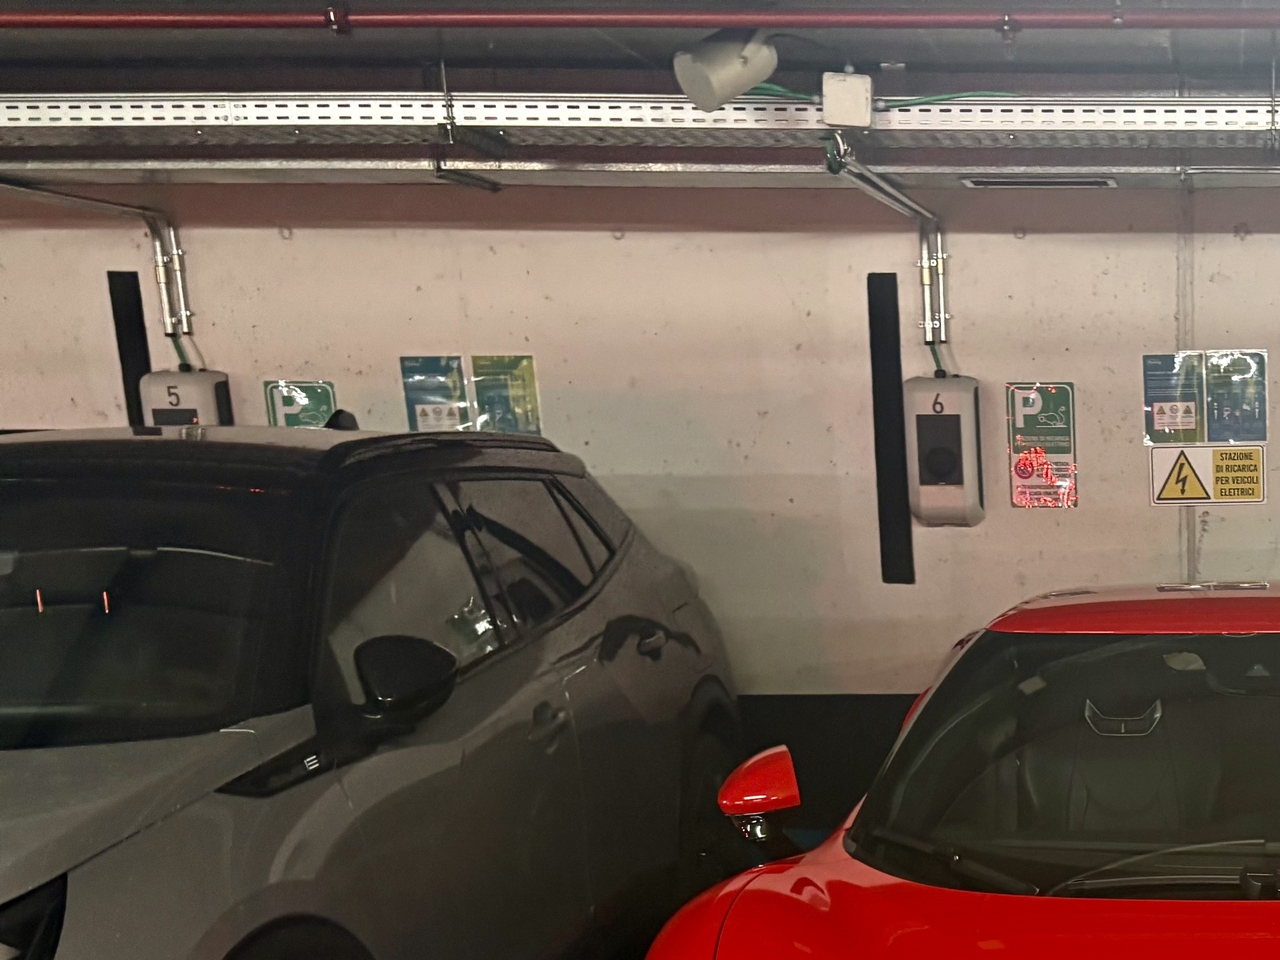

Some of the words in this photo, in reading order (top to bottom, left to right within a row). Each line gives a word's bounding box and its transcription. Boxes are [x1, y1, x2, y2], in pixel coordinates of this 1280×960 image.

[167, 386, 180, 407] 5
[932, 393, 944, 414] 6
[273, 387, 303, 426] P
[1014, 390, 1043, 428] P
[1220, 452, 1254, 461] STAZIONE
[1215, 464, 1224, 473] DI
[1225, 464, 1258, 473] RICARICA
[1215, 476, 1230, 485] PER
[1231, 476, 1259, 485] VEICOLI
[1220, 488, 1255, 496] ELETTRICI
